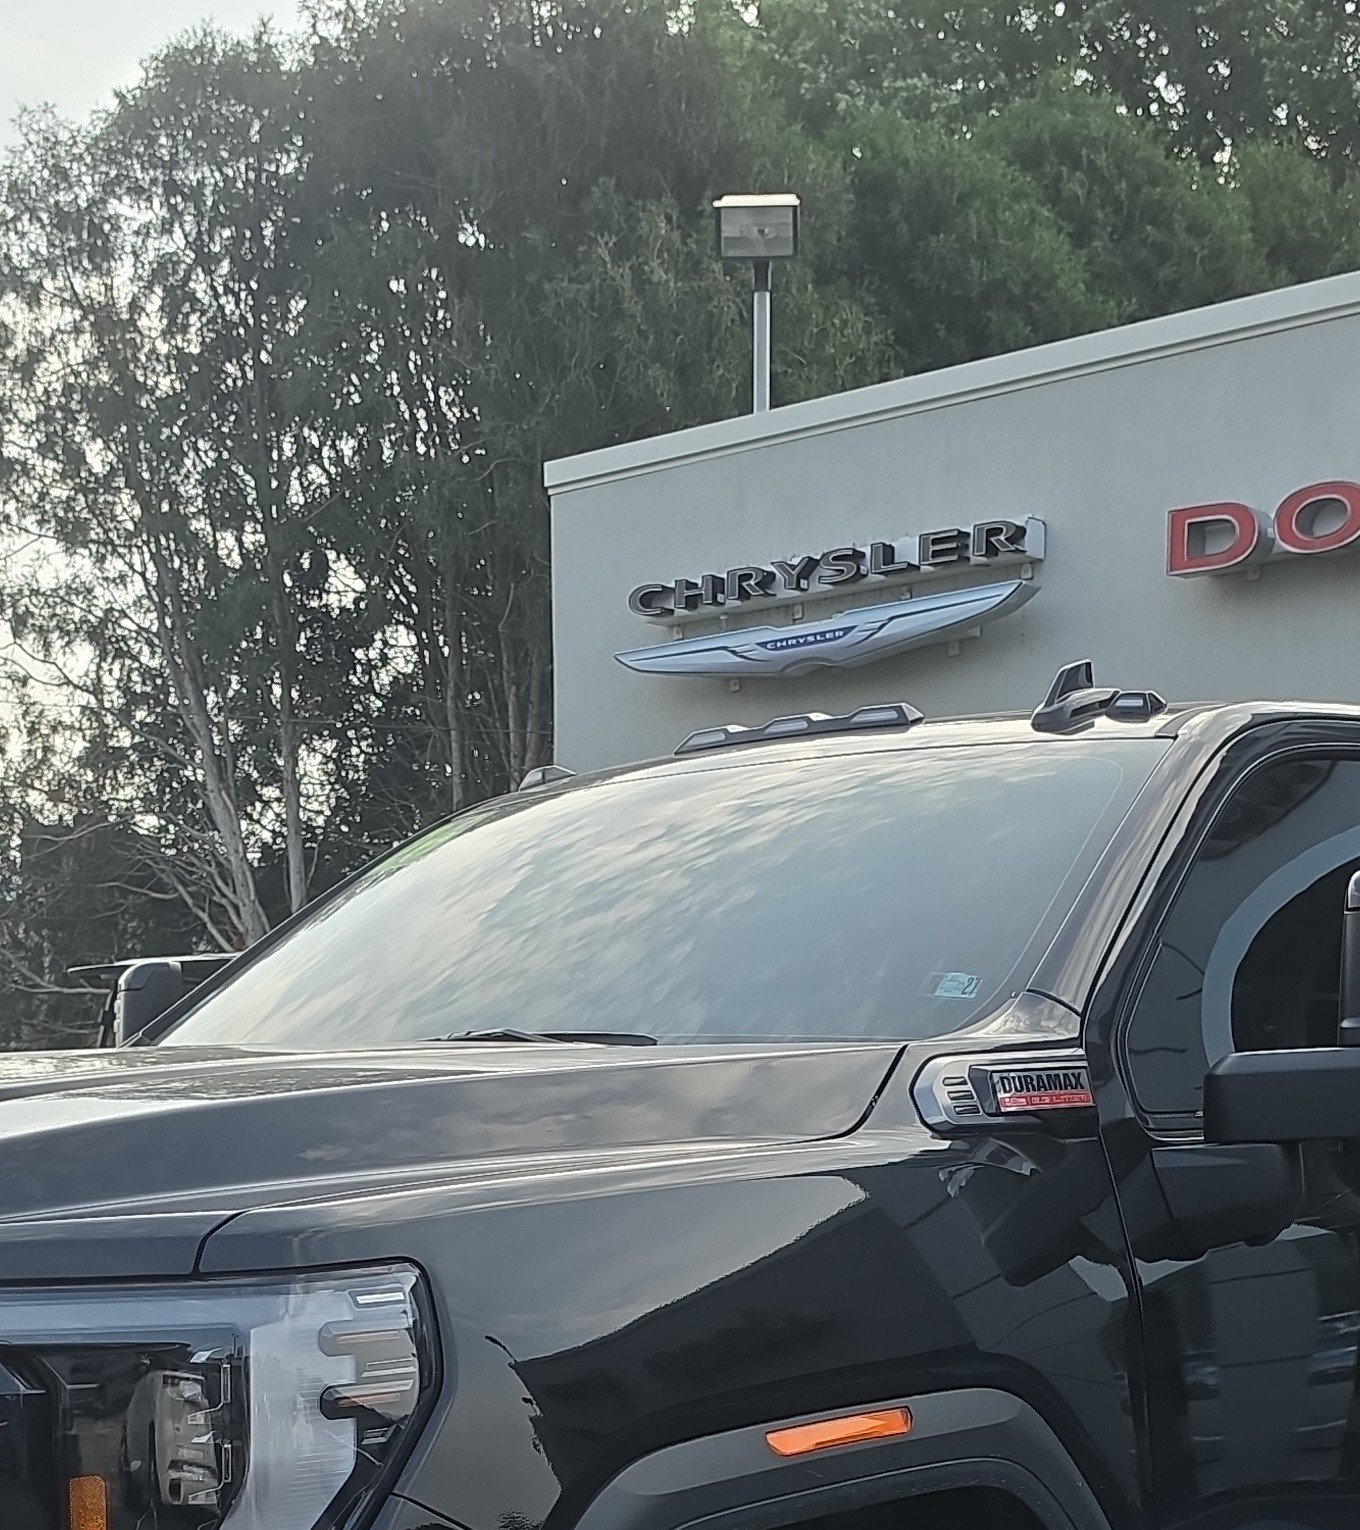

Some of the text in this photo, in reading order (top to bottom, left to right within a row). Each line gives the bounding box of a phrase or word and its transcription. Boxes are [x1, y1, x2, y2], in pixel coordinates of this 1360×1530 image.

[629, 520, 1028, 616] CHRYSLER
[766, 629, 845, 650] CHRYSLER
[960, 976, 981, 997] 27
[999, 1072, 1085, 1094] DURAMAX
